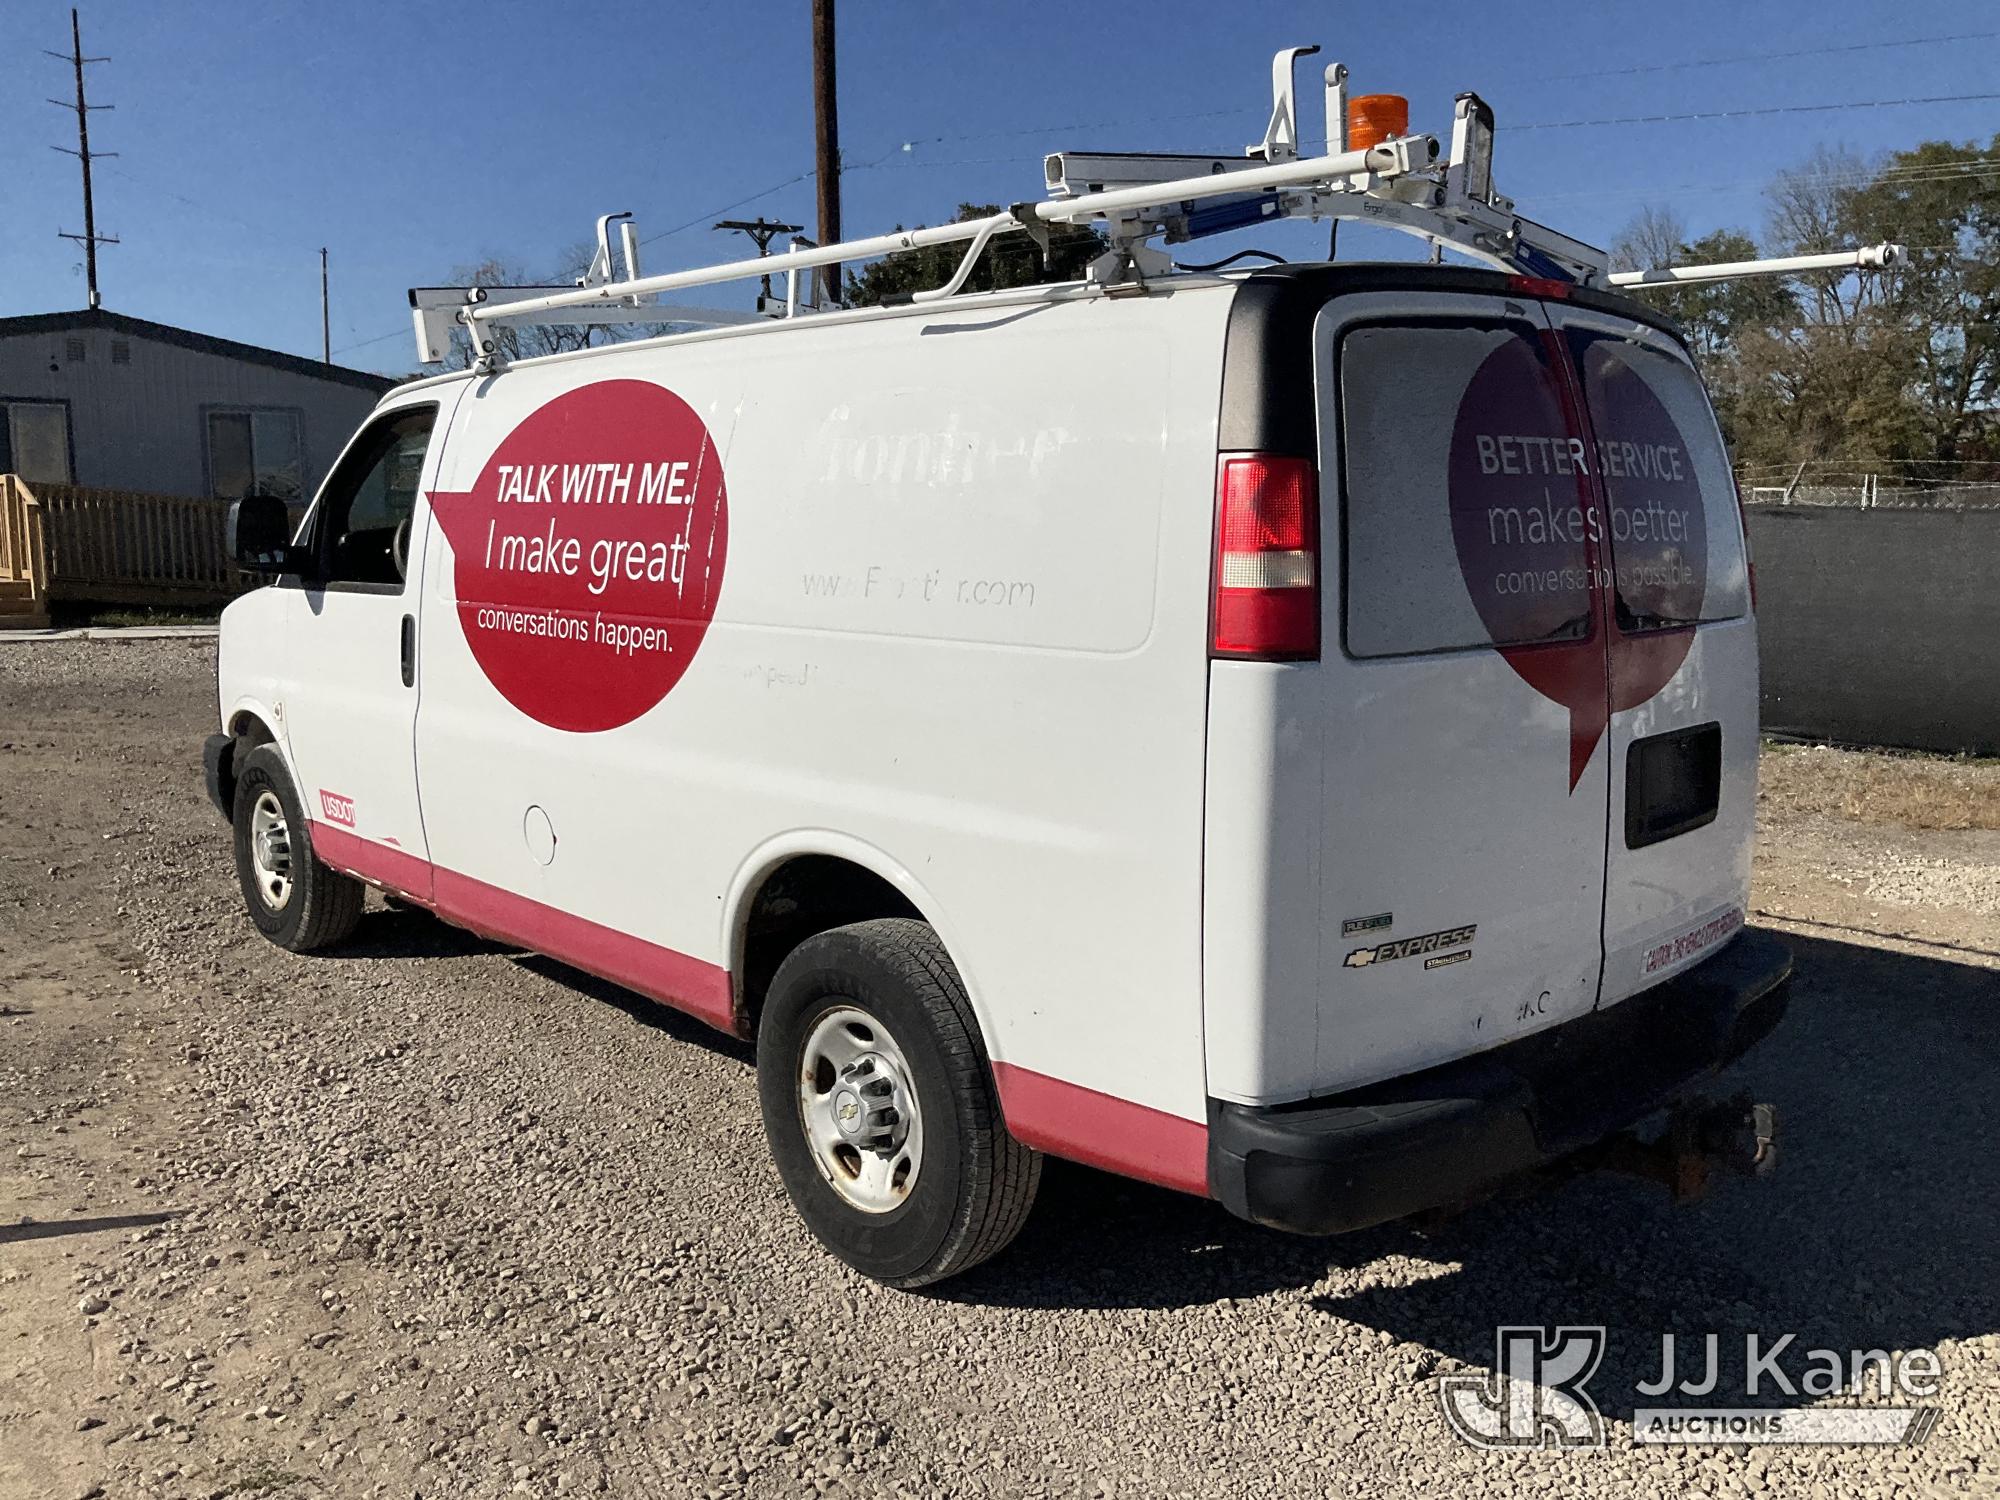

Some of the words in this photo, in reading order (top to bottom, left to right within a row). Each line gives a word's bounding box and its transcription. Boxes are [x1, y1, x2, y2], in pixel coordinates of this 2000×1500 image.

[1476, 434, 1589, 476] BETTER
[1593, 441, 1683, 481] SERVICE
[497, 464, 558, 503] TALK
[561, 462, 634, 504] WITH
[637, 461, 692, 505] ME.
[1488, 487, 1603, 544] makes
[1609, 488, 1689, 543] better
[485, 519, 496, 569] I
[499, 517, 581, 575] make
[588, 533, 687, 595] great
[478, 608, 589, 642] conversations
[594, 611, 673, 657] happen.
[322, 794, 356, 823] USDOT
[1374, 925, 1477, 964] EXPRESS
